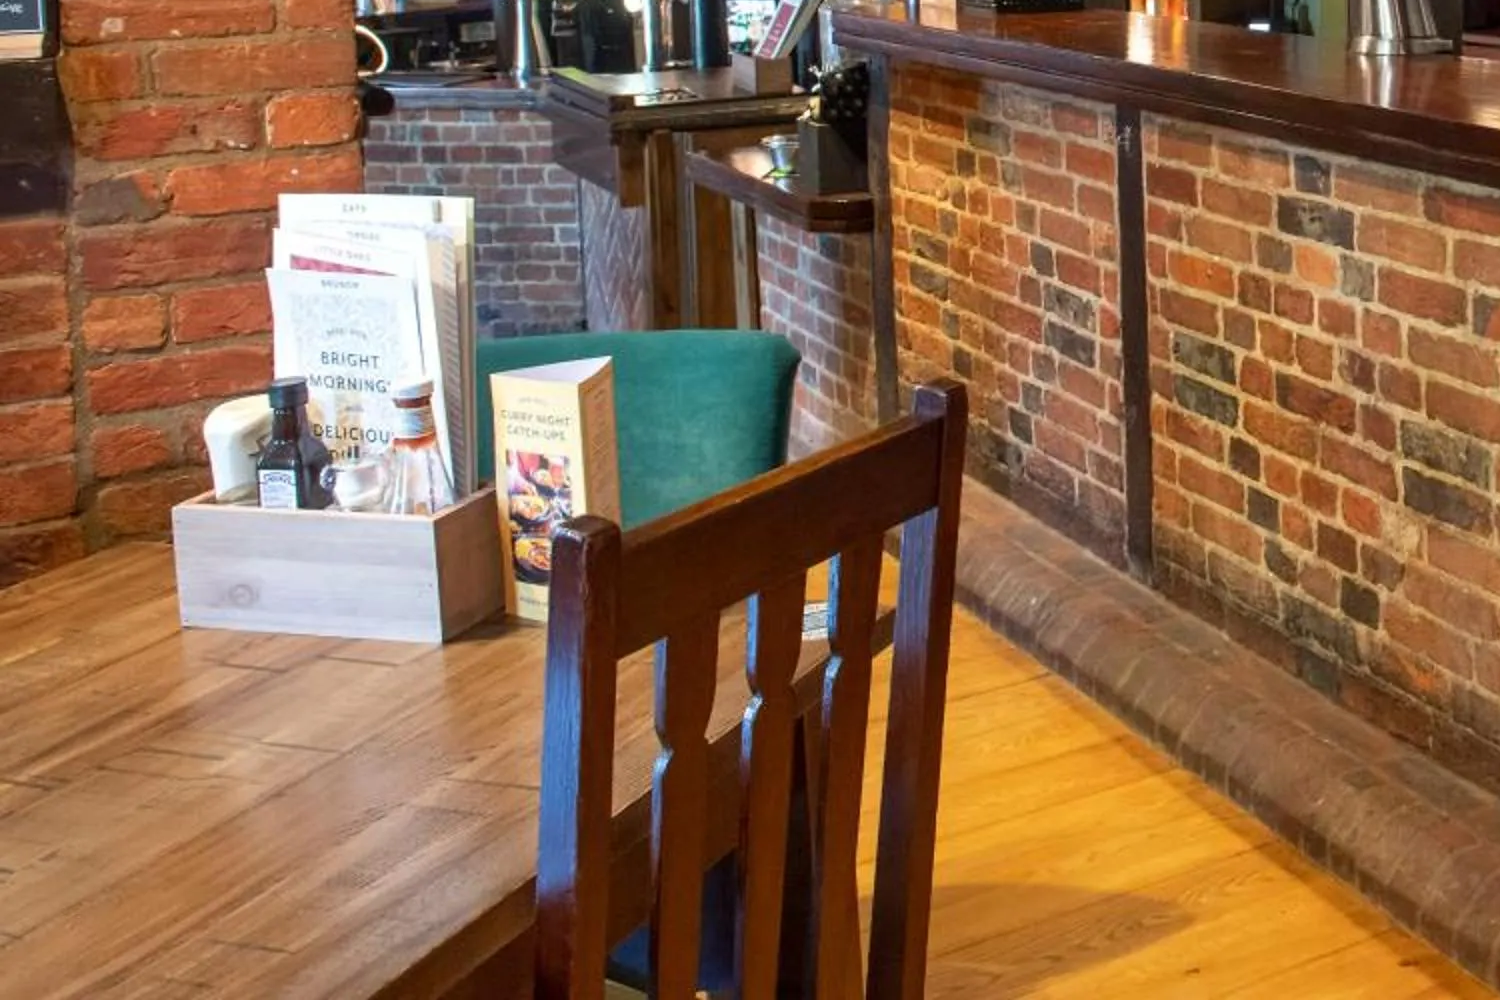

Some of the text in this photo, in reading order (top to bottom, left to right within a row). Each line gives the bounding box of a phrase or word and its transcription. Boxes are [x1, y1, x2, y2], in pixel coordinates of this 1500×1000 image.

[320, 351, 380, 369] BRIGHT
[309, 375, 391, 393] MORNING
[313, 423, 395, 444] DELICIOU
